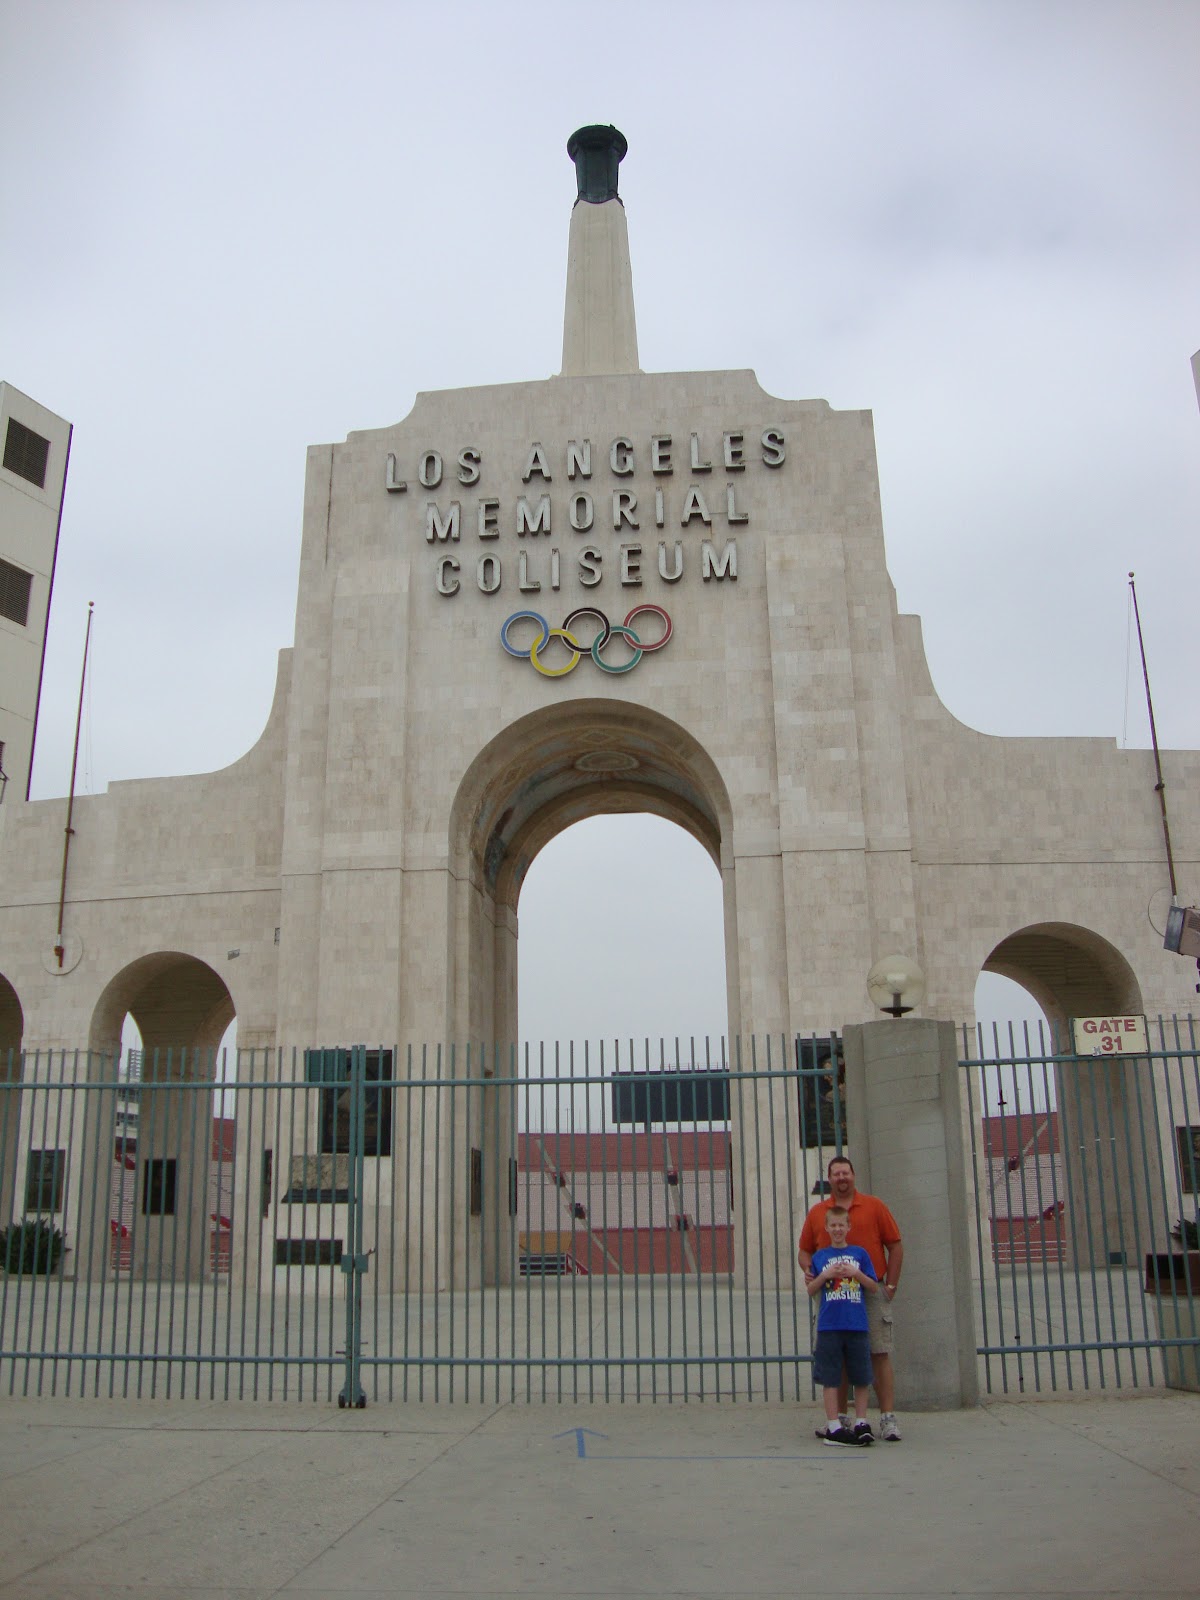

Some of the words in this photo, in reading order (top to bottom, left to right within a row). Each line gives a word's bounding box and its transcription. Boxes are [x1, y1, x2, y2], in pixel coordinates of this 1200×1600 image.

[385, 446, 482, 494] LOS
[522, 427, 786, 484] ANGELES
[426, 482, 749, 544] MEMORIAL
[435, 537, 738, 597] COLISEUM
[1083, 1019, 1136, 1034] GATE
[1101, 1036, 1123, 1051] 31
[825, 1291, 846, 1301] LOOKS
